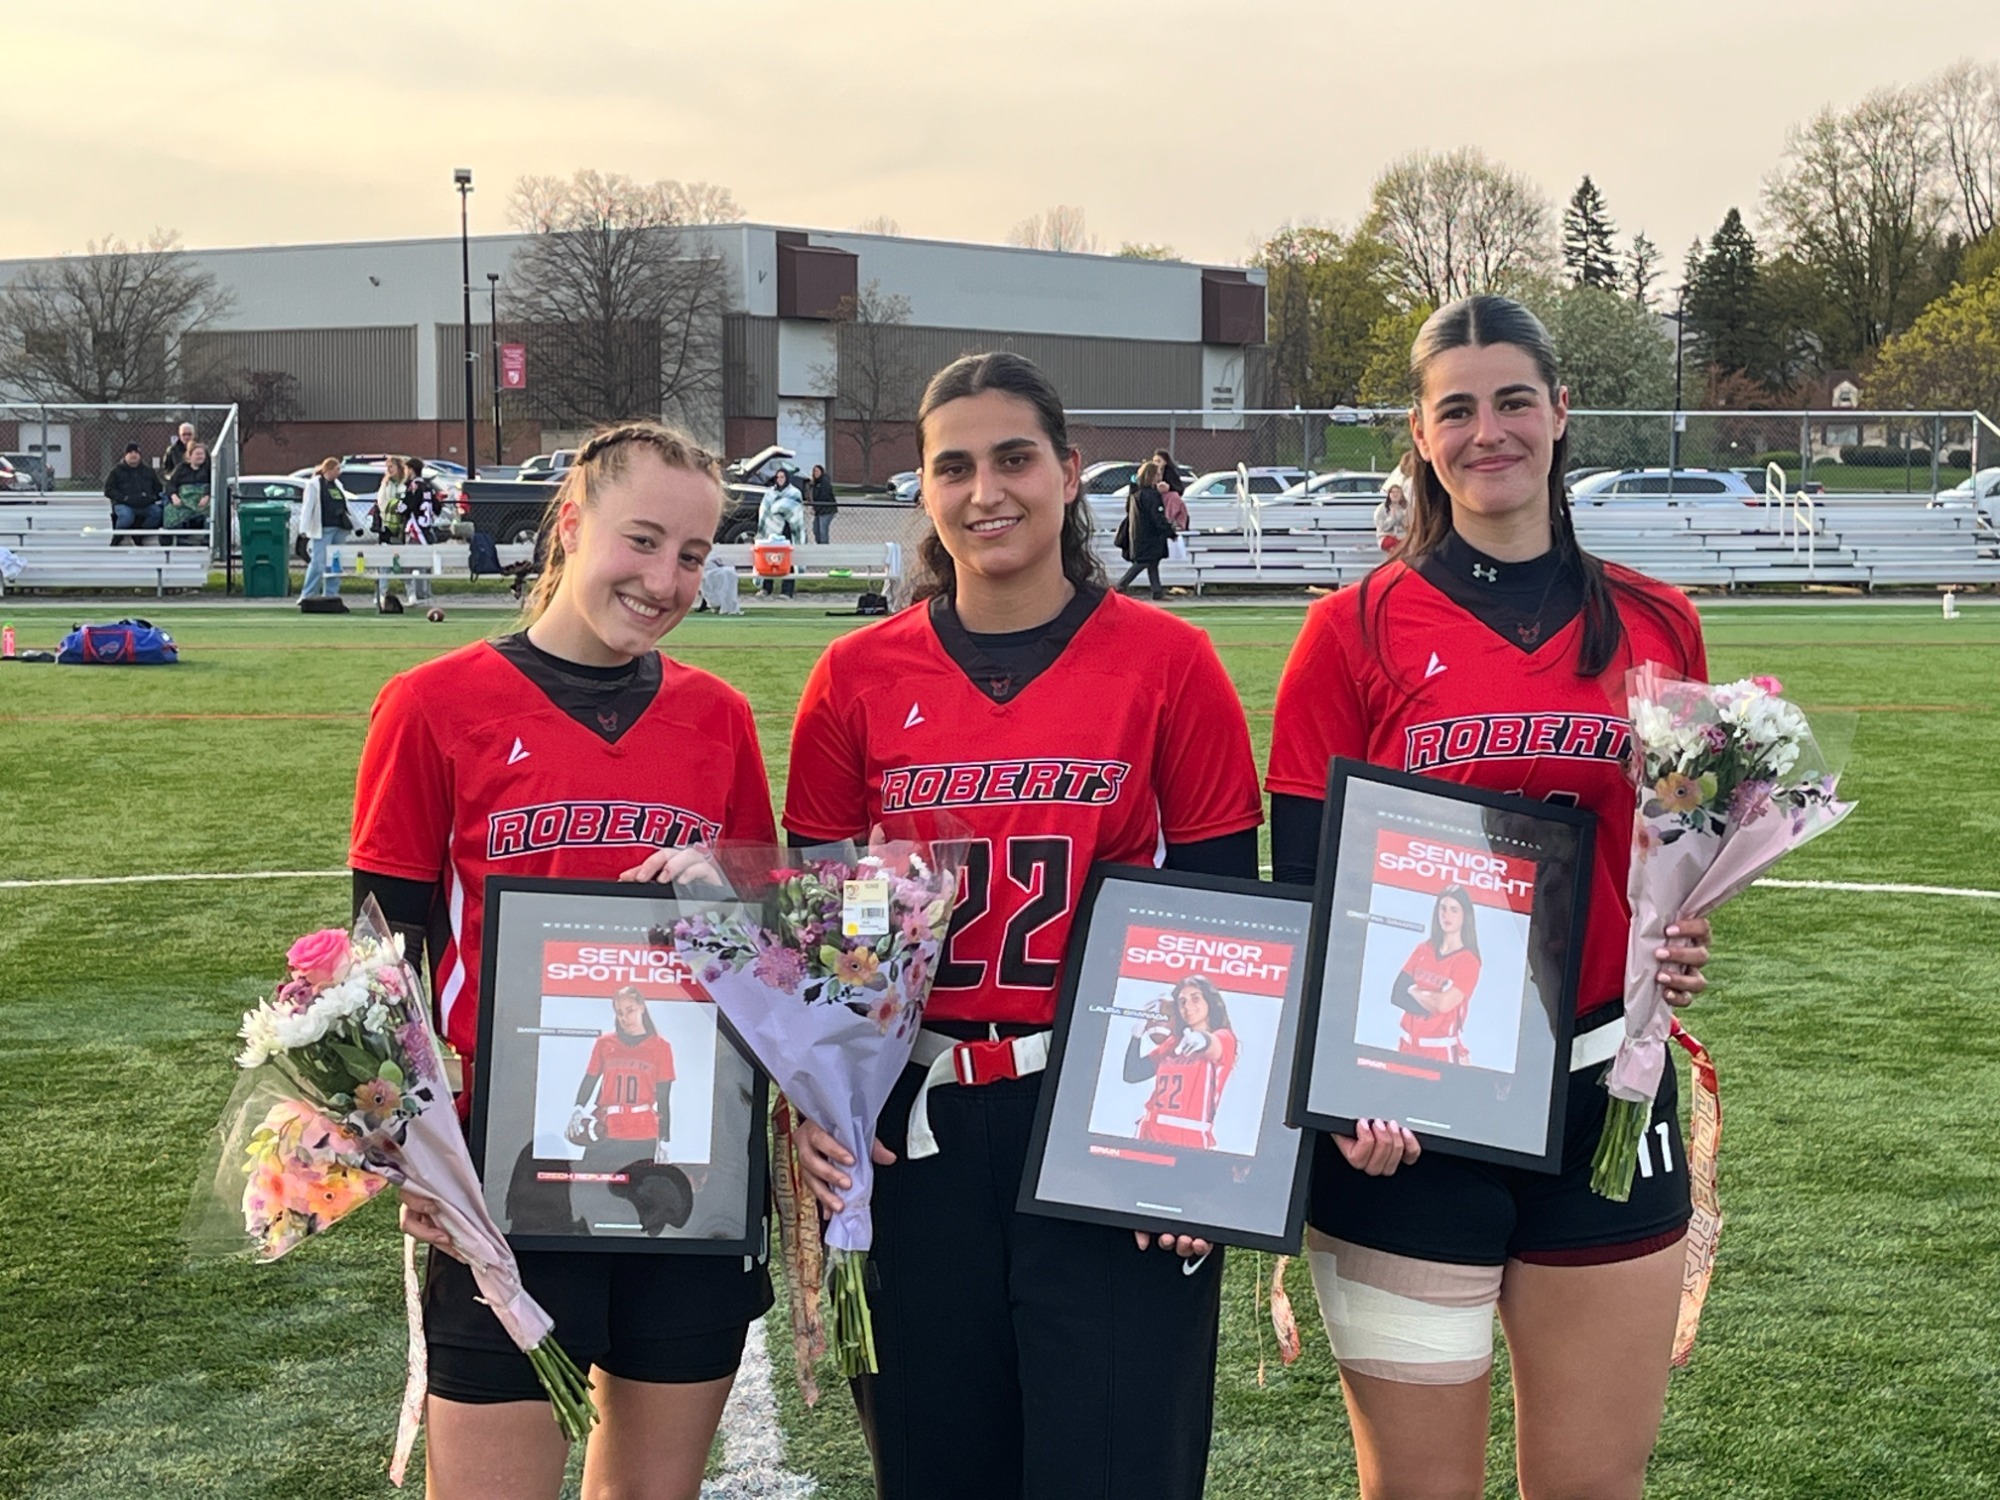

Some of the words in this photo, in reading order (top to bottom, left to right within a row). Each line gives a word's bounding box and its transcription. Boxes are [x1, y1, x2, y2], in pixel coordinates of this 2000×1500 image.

[1404, 712, 1633, 773] ROBERT
[882, 758, 1131, 813] ROBERTS
[1378, 852, 1534, 898] SPOTLIGHT
[1407, 840, 1508, 876] SENIOR
[929, 835, 1072, 990] 22
[1234, 920, 1301, 934] FOOTBALL
[1126, 947, 1288, 981] SPOTLIGHT
[1156, 934, 1263, 962] SENIOR
[547, 963, 698, 985] SPOTLIGH
[1088, 1004, 1122, 1015] LAURA
[616, 1073, 638, 1105] 10
[1155, 1073, 1184, 1110] 22
[1682, 1083, 1717, 1295] ROBERTS
